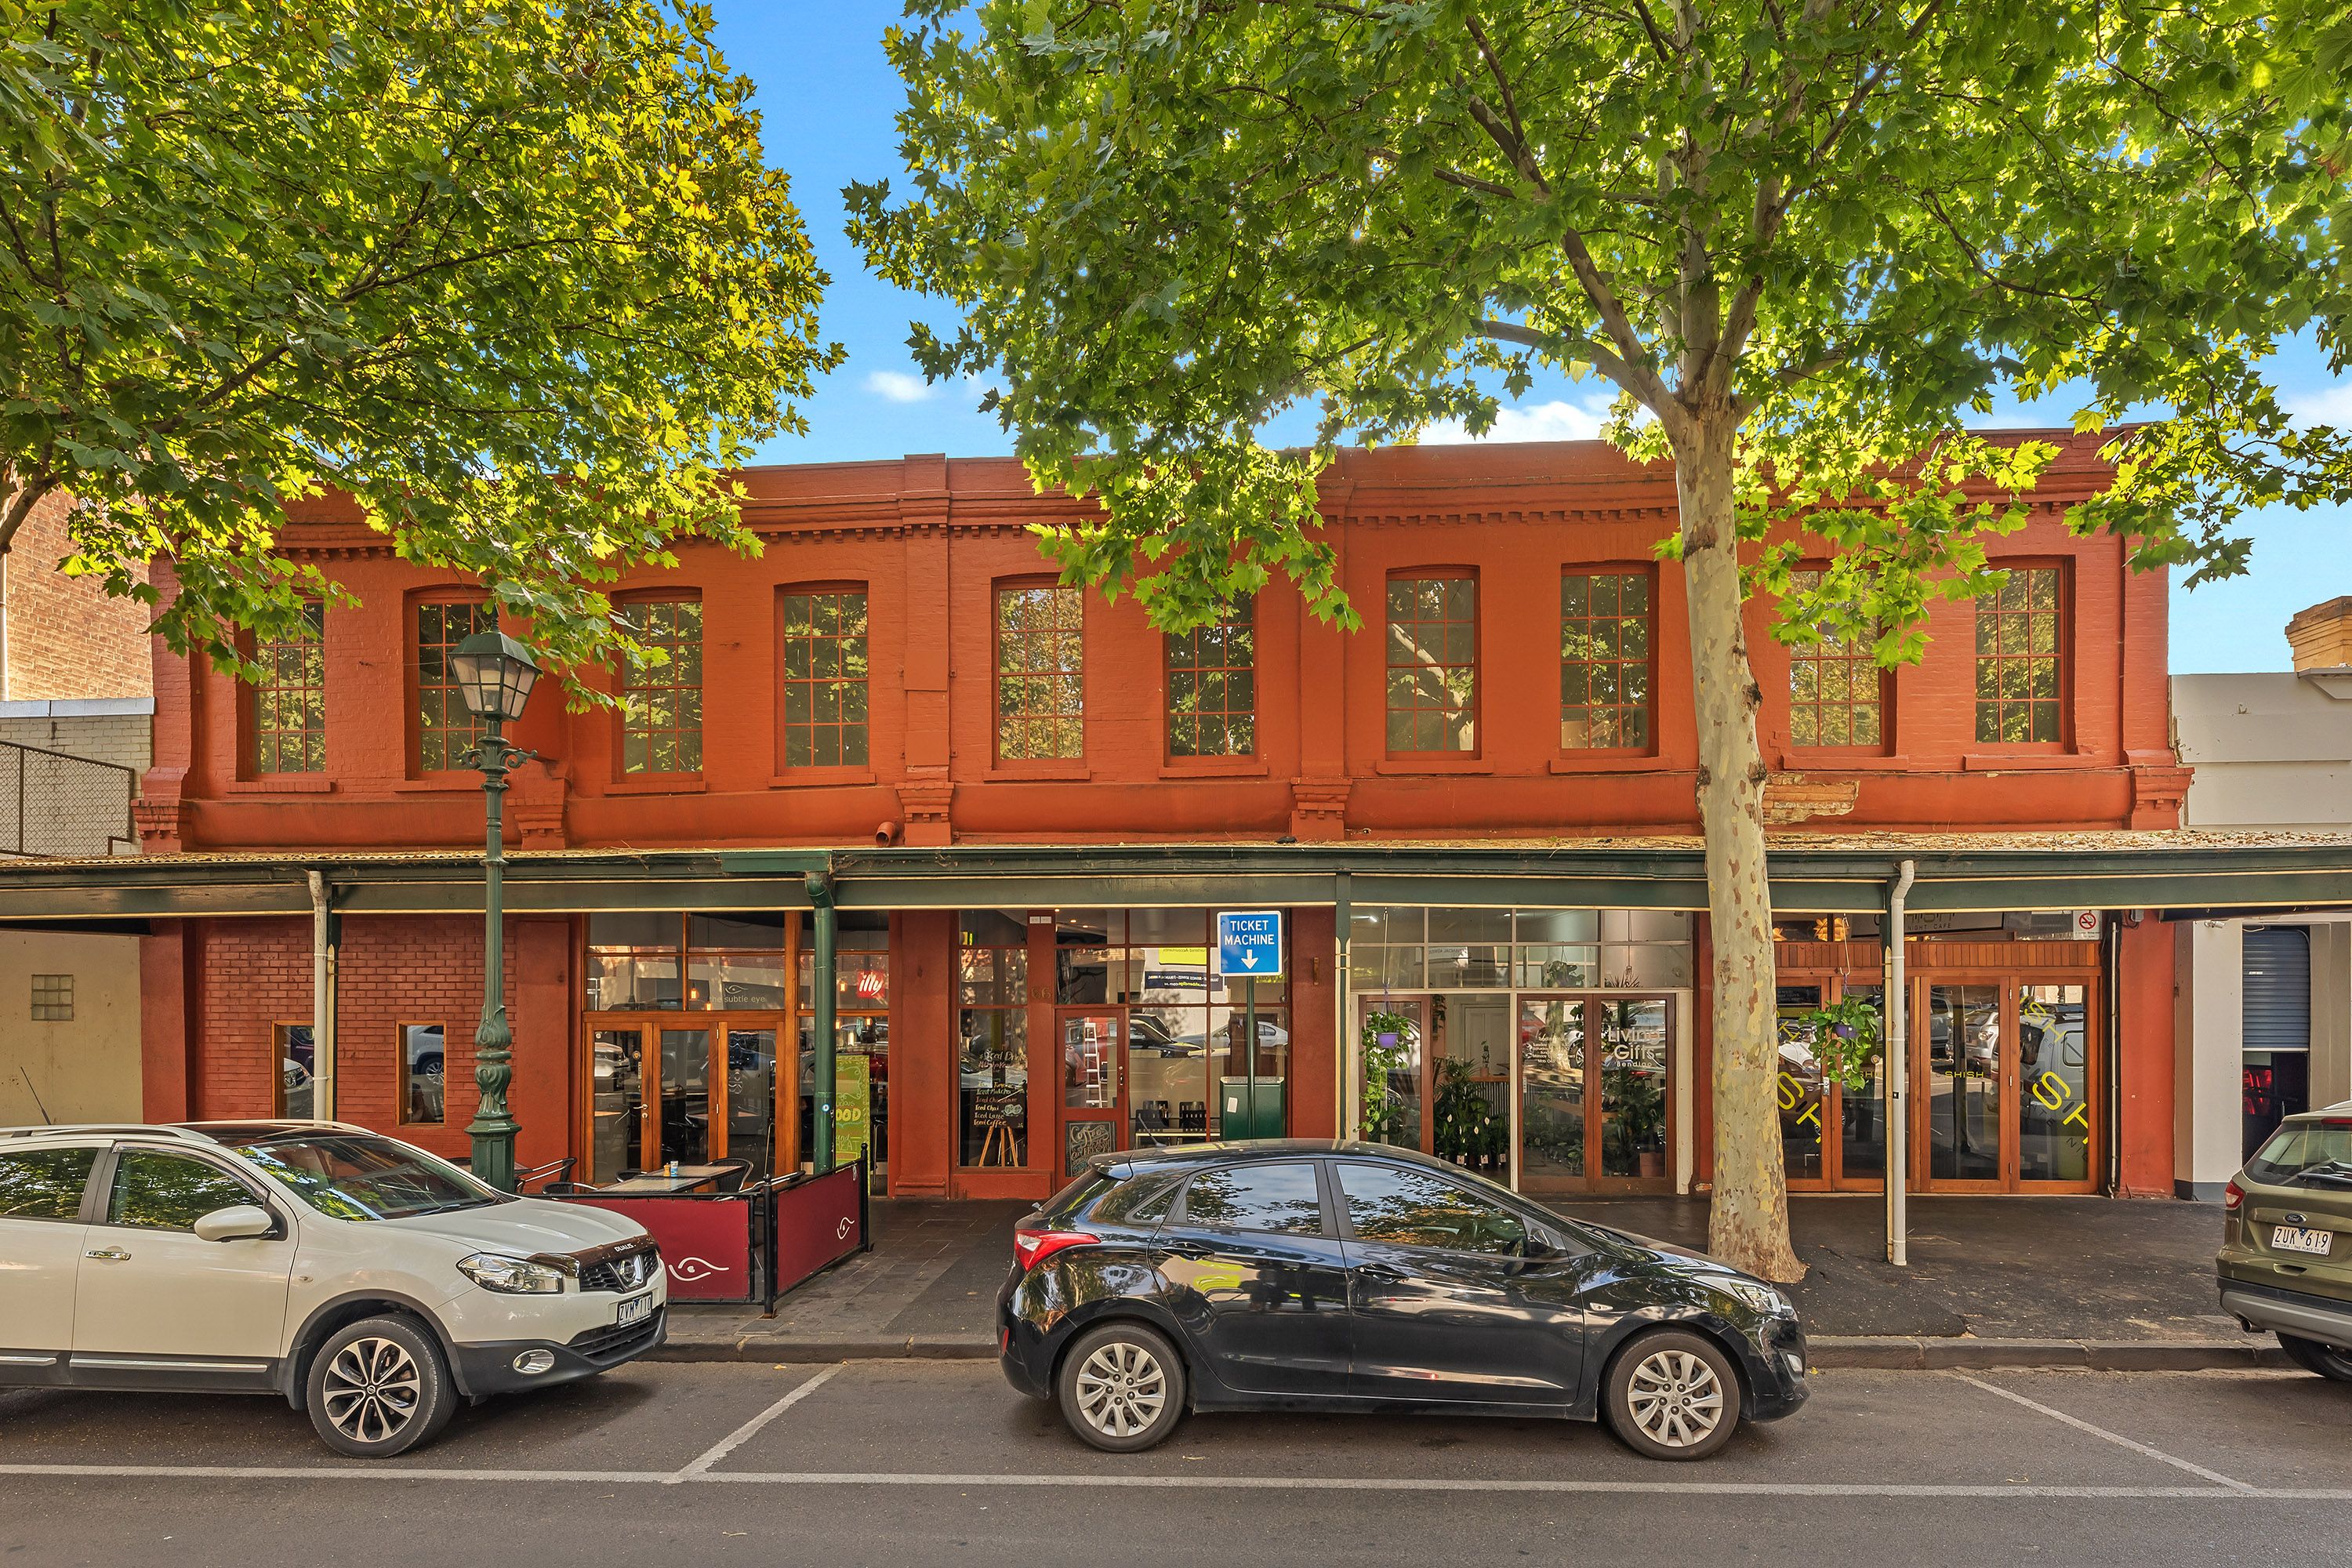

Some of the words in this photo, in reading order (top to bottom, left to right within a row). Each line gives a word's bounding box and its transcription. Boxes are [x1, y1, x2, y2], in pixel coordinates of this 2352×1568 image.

[1230, 920, 1269, 931] TICKET
[1225, 935, 1275, 946] MACHINE
[859, 974, 884, 996] illy
[1608, 1025, 1661, 1046] Living
[1614, 1044, 1655, 1061] Gifts
[836, 1108, 862, 1122] OOD
[987, 1120, 1007, 1128] Coffee
[2275, 1229, 2297, 1244] ZUK
[2306, 1232, 2328, 1247] 619
